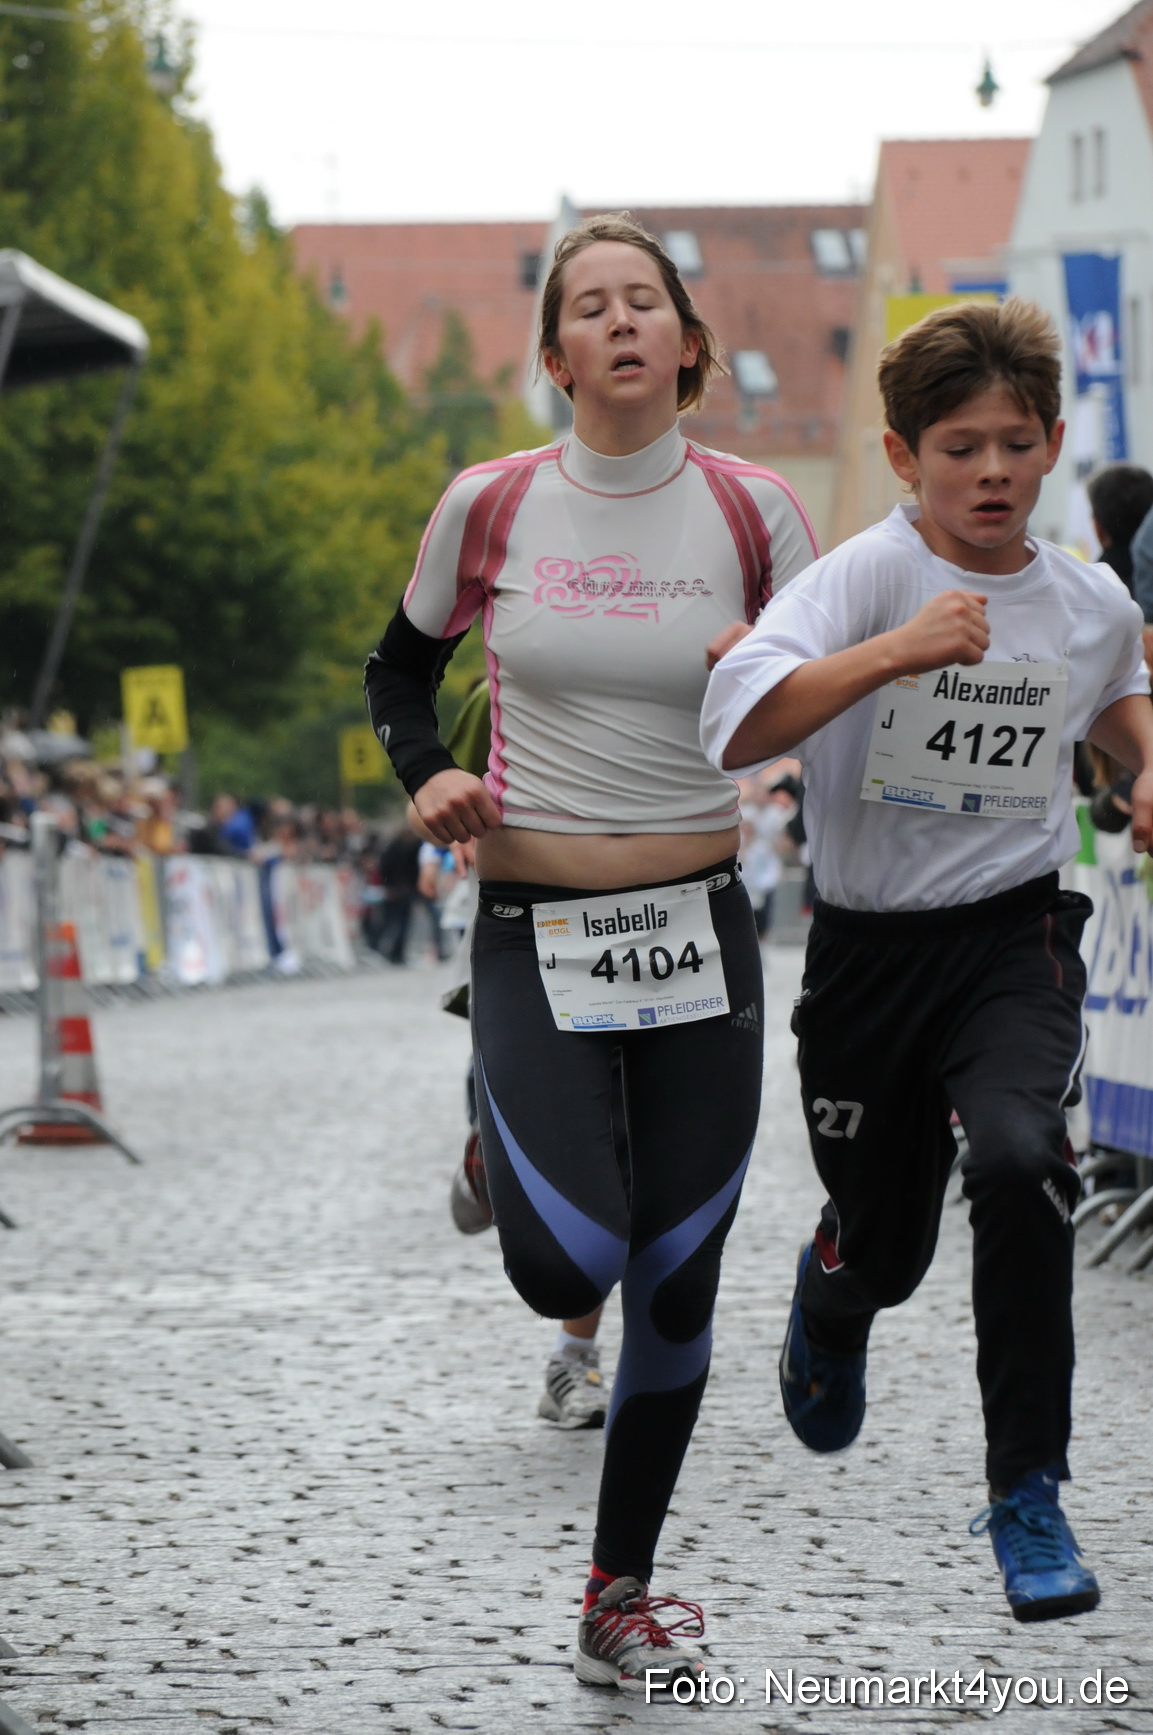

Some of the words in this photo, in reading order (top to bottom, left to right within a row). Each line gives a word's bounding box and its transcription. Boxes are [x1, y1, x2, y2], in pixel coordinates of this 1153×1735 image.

[933, 670, 1051, 707] Alexander
[881, 709, 895, 730] J
[925, 720, 1046, 768] 4127
[882, 785, 935, 802] BOCK
[983, 794, 1048, 810] PFLEIDERER
[583, 902, 668, 938] Isabella
[546, 953, 557, 970] J
[590, 941, 704, 984] 4104
[657, 996, 725, 1017] PFLEIDERER
[571, 1013, 616, 1026] BOCK
[812, 1097, 864, 1139] 27
